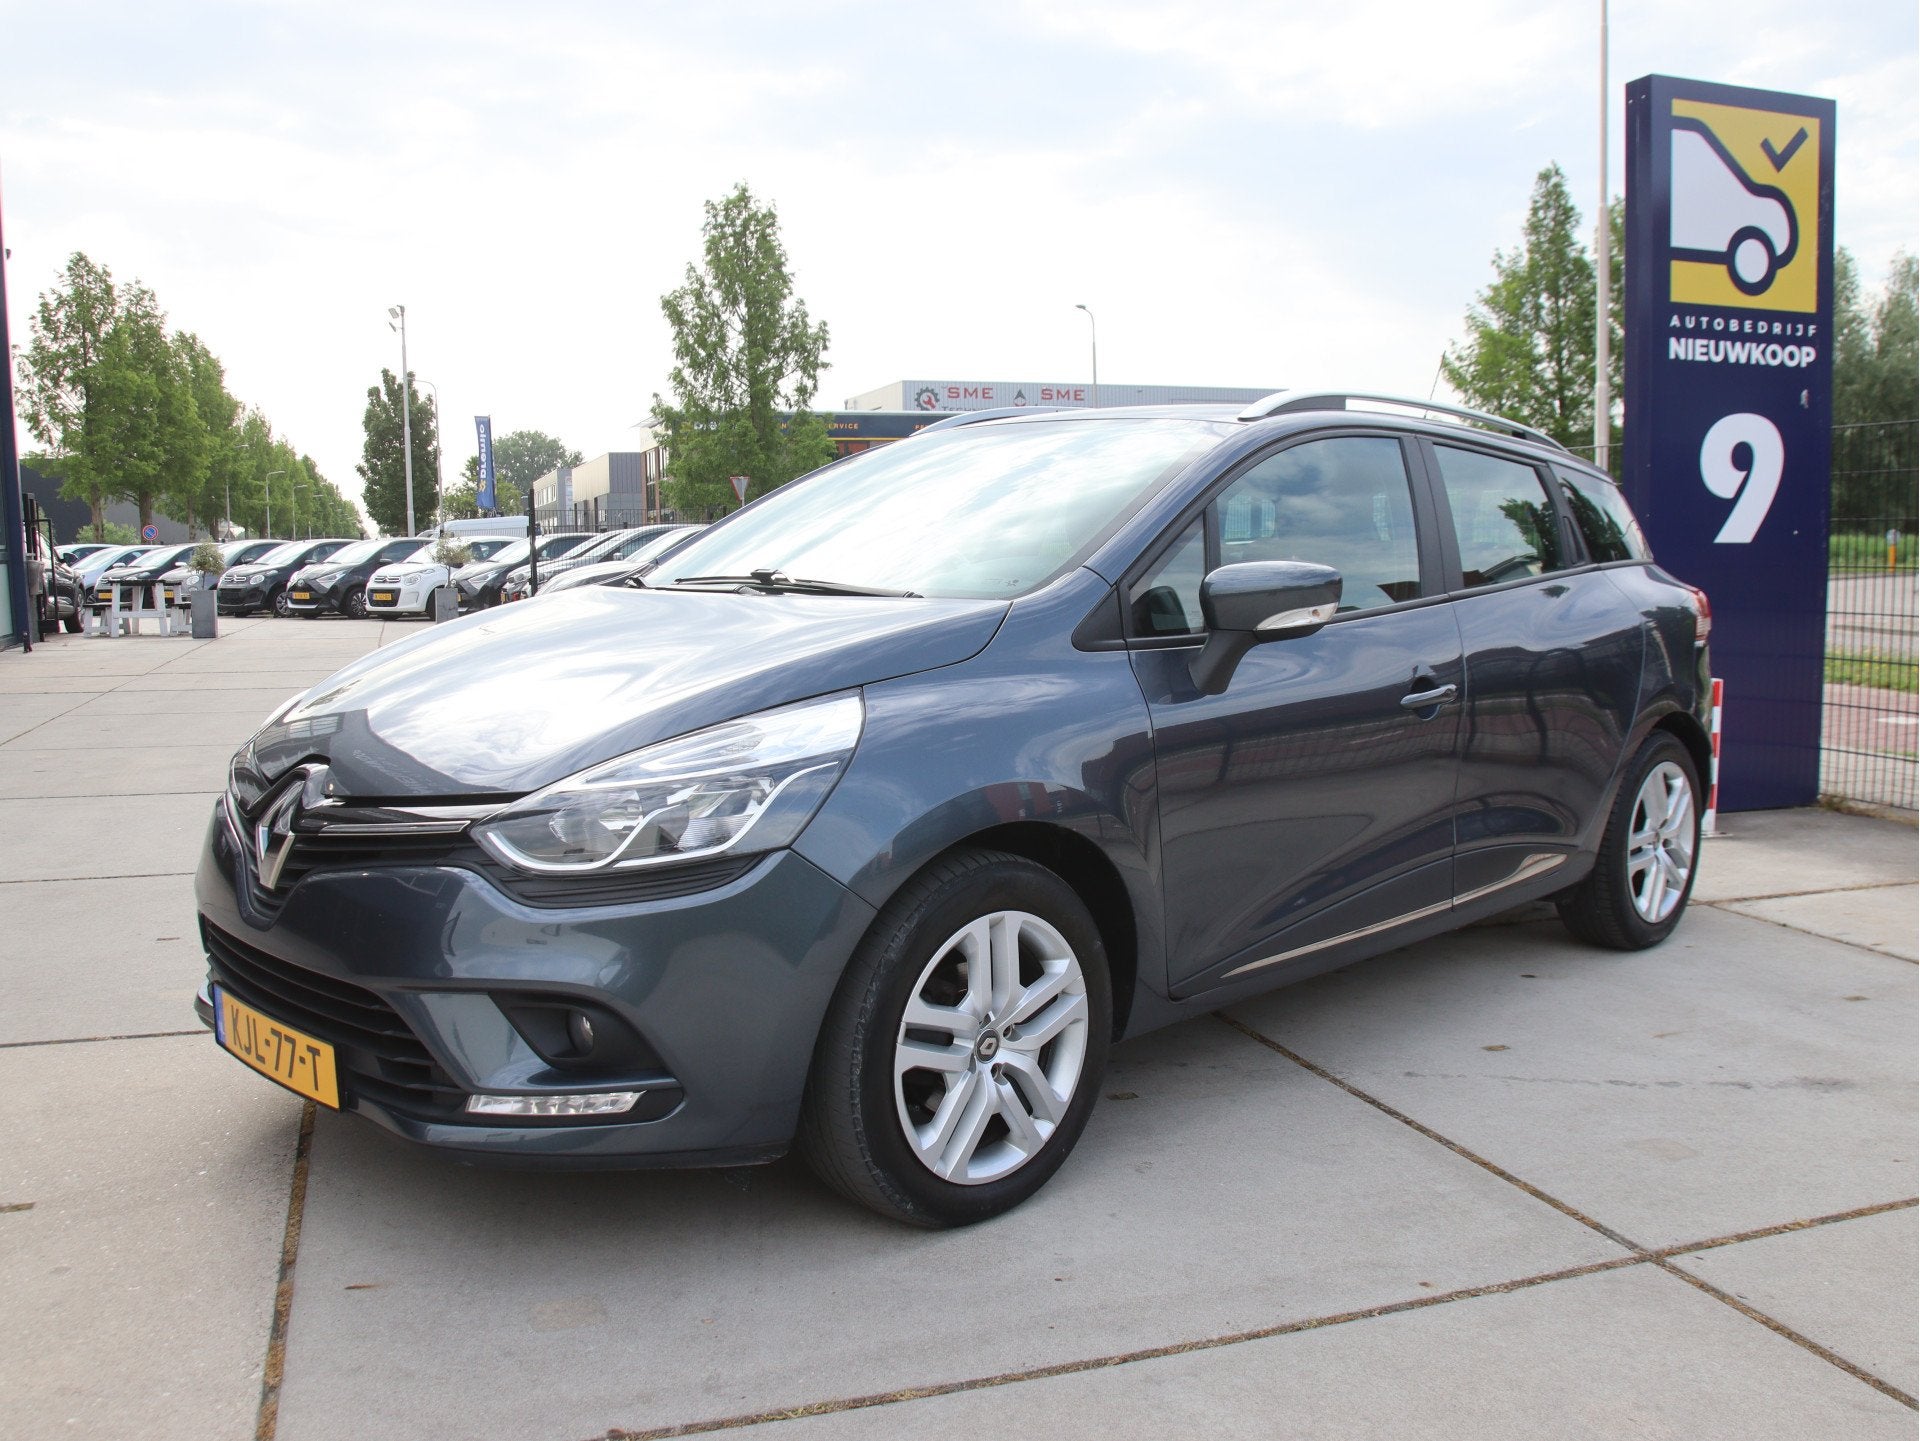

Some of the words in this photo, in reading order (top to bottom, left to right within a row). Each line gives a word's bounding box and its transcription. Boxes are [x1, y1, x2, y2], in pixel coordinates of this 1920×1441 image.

[1669, 314, 1818, 338] AUTOBEDRIJF
[1668, 336, 1817, 368] NIEUWKOOP
[947, 387, 994, 400] SME
[1041, 388, 1086, 401] SME
[1700, 411, 1785, 544] 9
[230, 1004, 321, 1092] KJL-77-T
